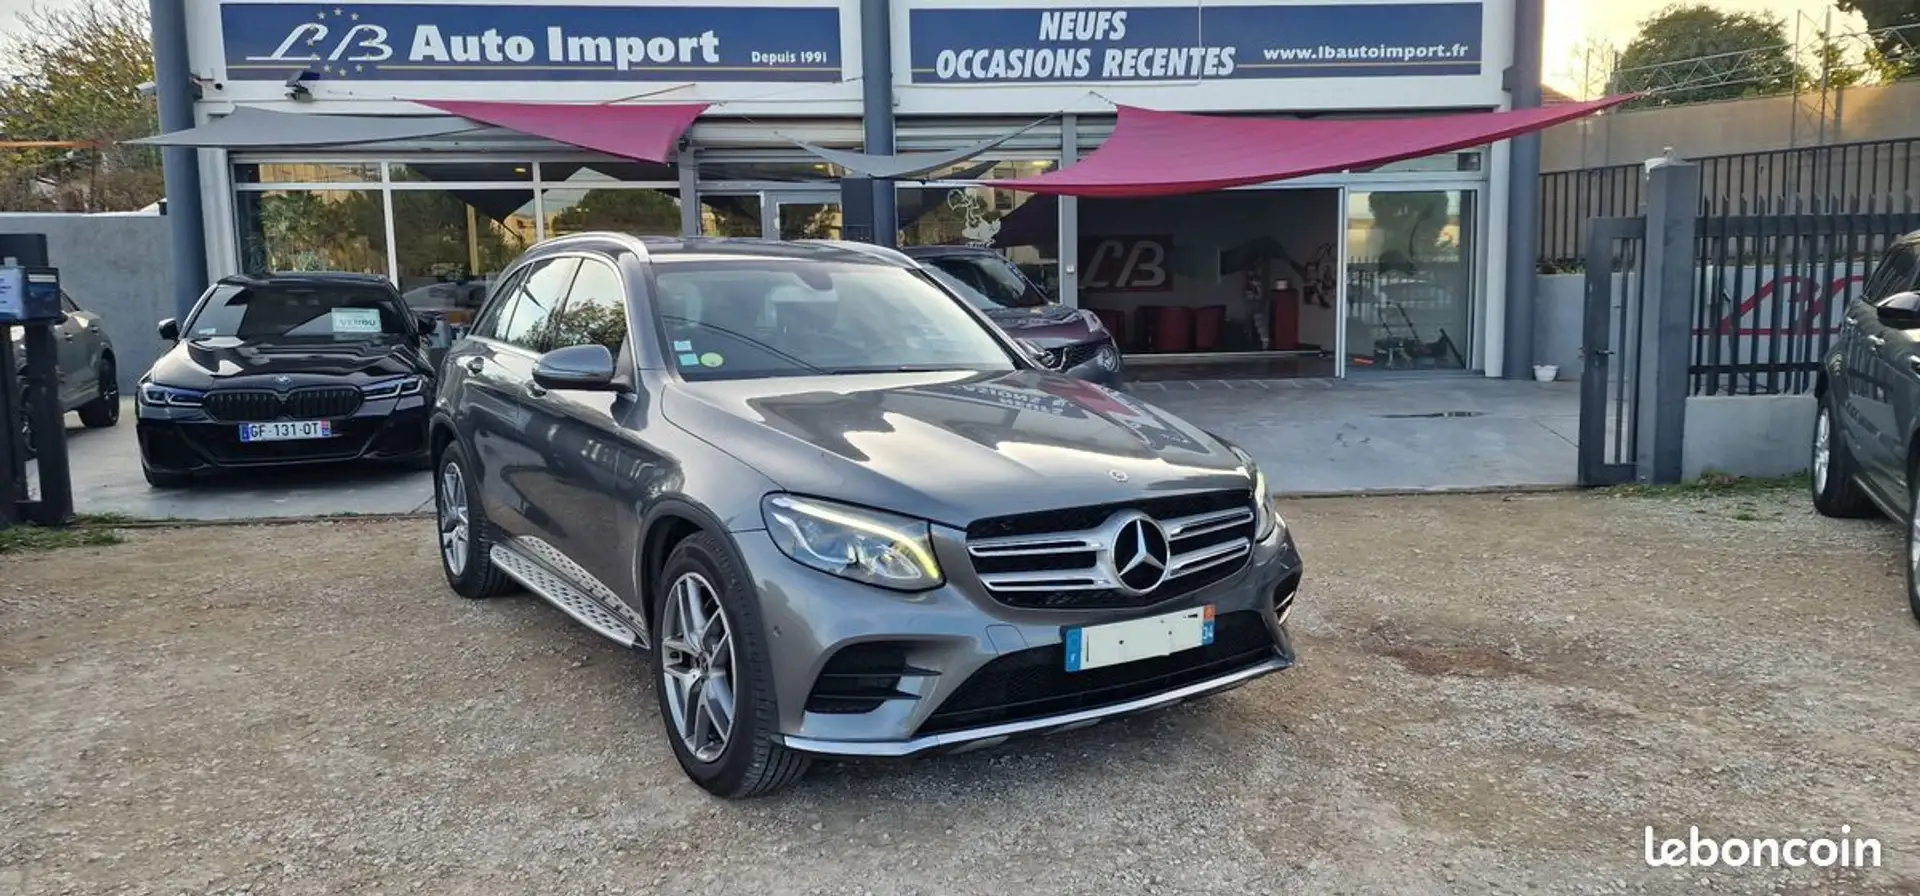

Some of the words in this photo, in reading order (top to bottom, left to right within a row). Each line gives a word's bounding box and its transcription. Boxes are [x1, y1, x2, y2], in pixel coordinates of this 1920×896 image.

[1039, 11, 1127, 41] NEUFS
[246, 22, 394, 62] LB
[408, 24, 535, 62] Auto
[547, 25, 720, 71] Import
[751, 50, 796, 65] Depuis
[800, 51, 828, 63] 1991
[1263, 43, 1469, 62] www.lbautoimport.fr
[935, 48, 1091, 79] OCCASIONS
[1102, 46, 1236, 77] RECENTES
